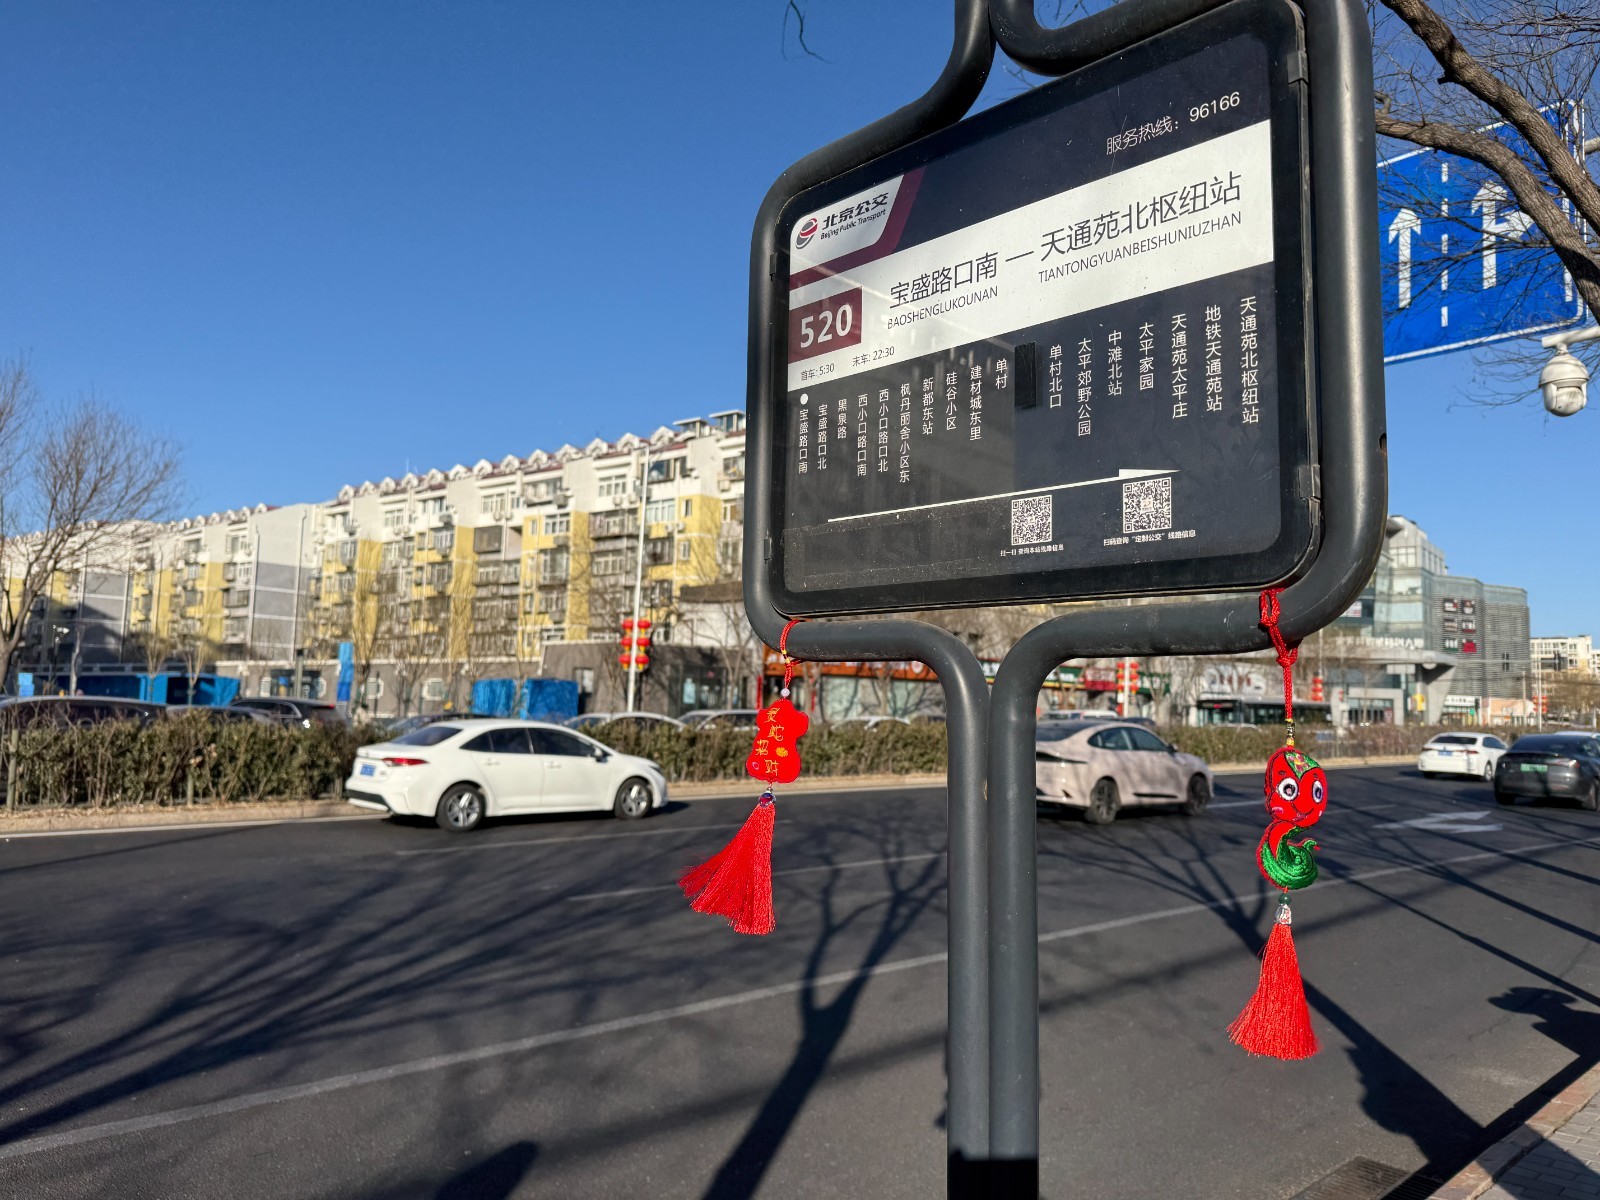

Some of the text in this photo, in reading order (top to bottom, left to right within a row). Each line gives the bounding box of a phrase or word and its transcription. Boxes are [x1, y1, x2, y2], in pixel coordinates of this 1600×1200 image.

[1189, 91, 1242, 123] 96166
[820, 209, 887, 240] Beijing Public Transport
[822, 193, 889, 230] 北京公交
[889, 250, 999, 309] 宝盛路口南
[1041, 170, 1243, 262] 天通苑北枢纽站
[1038, 210, 1243, 284] TIANTONGYUANBEISHUNIUZHAN
[799, 303, 853, 349] 520
[887, 285, 999, 331] BAOSHENGLUKOUNAN
[819, 363, 835, 376] 5:30
[873, 346, 895, 361] 22:30
[995, 357, 1008, 390] 单村
[1049, 344, 1063, 409] 单村北口
[1077, 337, 1092, 437] 太平郊野公园
[1107, 329, 1123, 397] 中滩北站
[1139, 321, 1155, 391] 太平家园
[1171, 312, 1188, 420] 天通苑太平庄
[1205, 304, 1223, 412] 地铁天通苑站
[1240, 295, 1259, 425] 天通苑北枢纽站
[837, 398, 848, 440] 黑泉路
[877, 388, 889, 473] 西小口路口北
[899, 382, 911, 483] 枫丹丽舍小区东
[922, 376, 934, 436] 新都东站
[945, 370, 958, 431] 硅谷小区
[969, 364, 982, 441] 建材城东里
[798, 408, 809, 475] 宝盛路口南
[817, 403, 828, 471] 宝盛路口北
[857, 393, 868, 477] 西小口路口南
